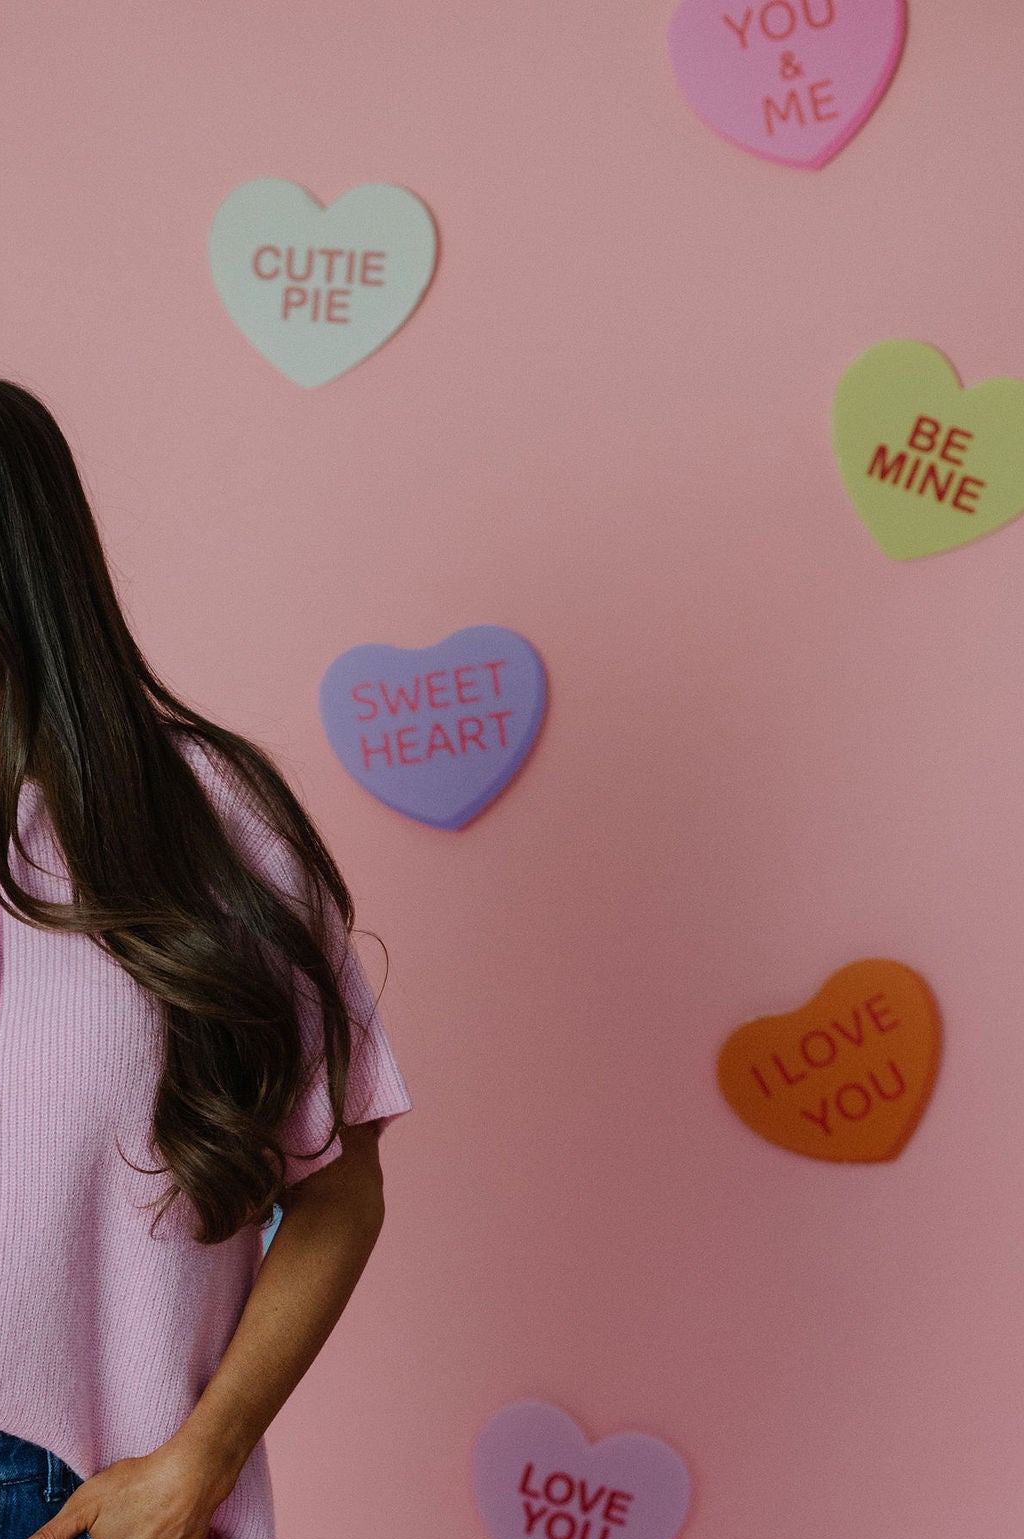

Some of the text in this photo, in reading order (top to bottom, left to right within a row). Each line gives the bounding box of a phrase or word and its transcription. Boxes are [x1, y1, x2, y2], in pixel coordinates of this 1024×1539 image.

[721, 0, 838, 50] YOU
[778, 50, 806, 80] &
[763, 81, 836, 136] ME
[253, 245, 384, 286] CUTIE
[281, 288, 350, 324] PIE
[907, 415, 973, 467] BE
[867, 444, 984, 514] MINE
[351, 660, 506, 721] SWEET
[360, 712, 512, 769] HEART
[751, 993, 900, 1099] I LOVE
[802, 1061, 905, 1137] YOU
[519, 1462, 632, 1527] LOVE
